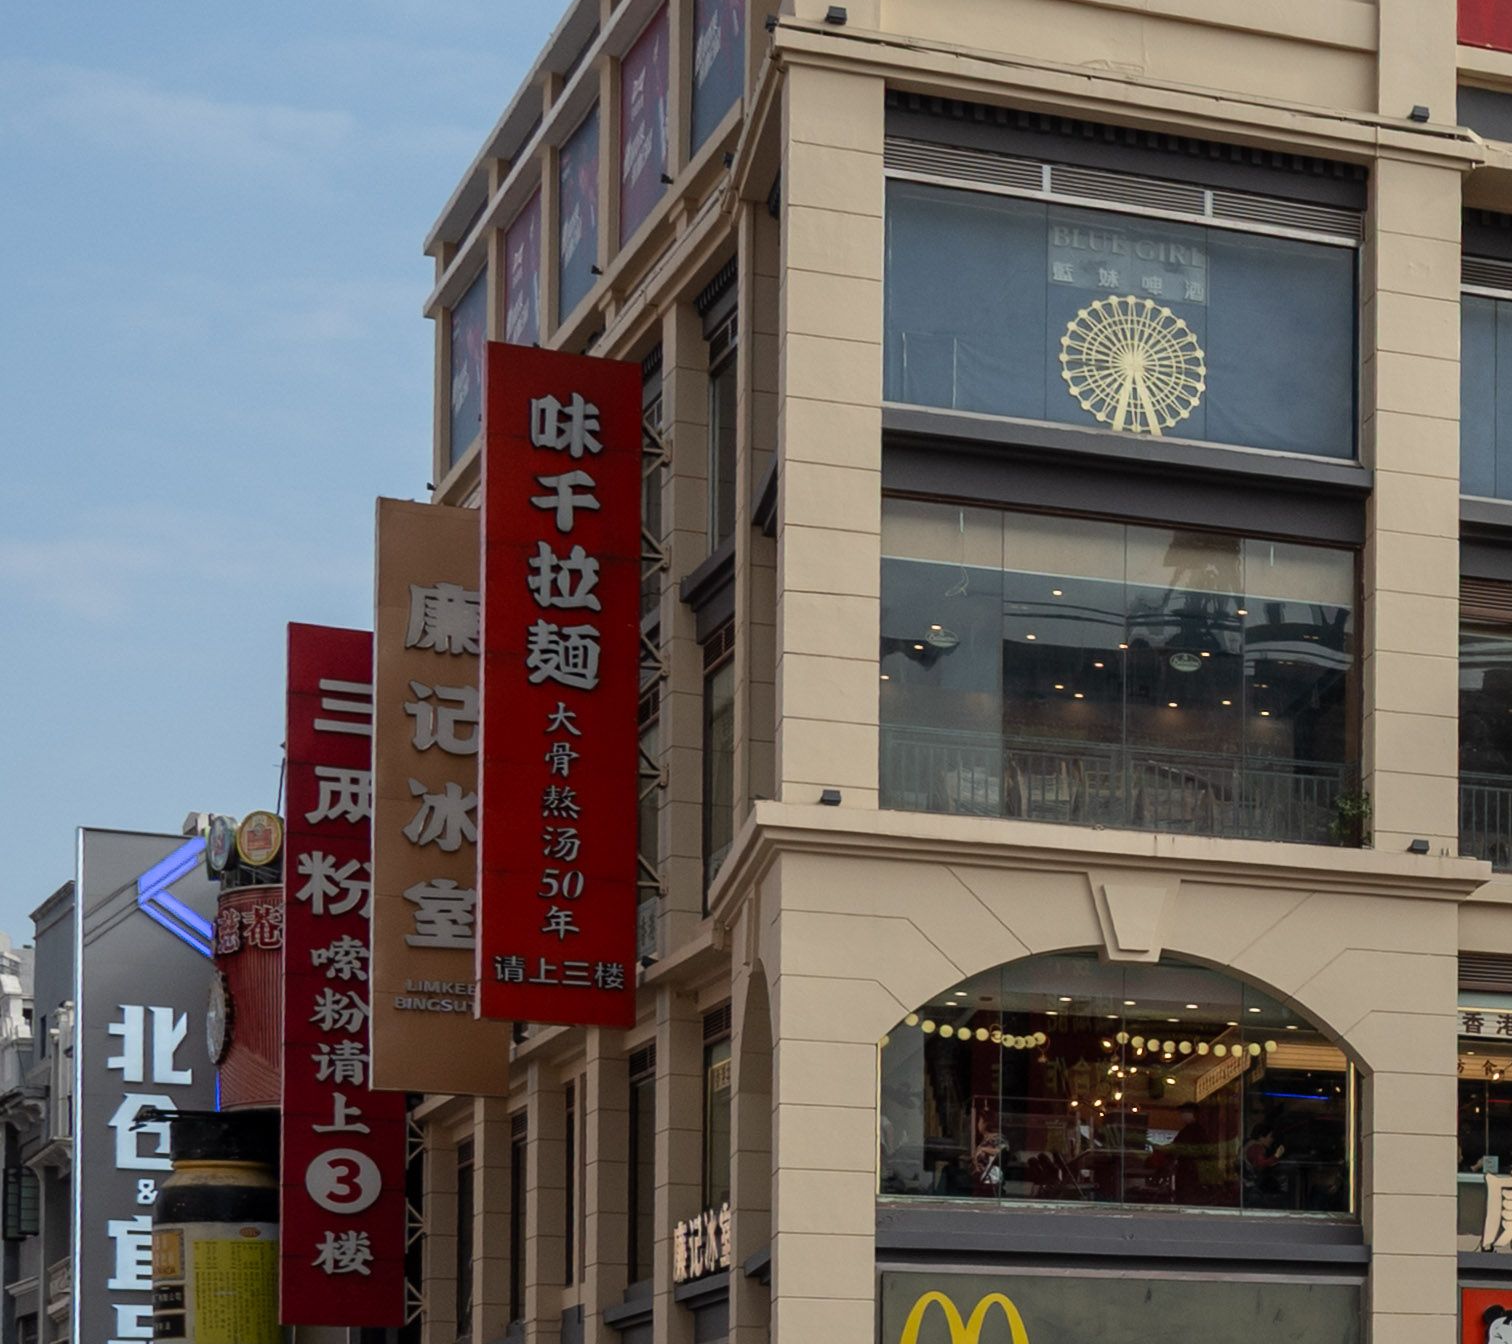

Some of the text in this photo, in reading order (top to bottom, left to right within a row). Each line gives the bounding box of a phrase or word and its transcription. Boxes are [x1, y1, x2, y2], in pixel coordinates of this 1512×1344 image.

[538, 700, 585, 940] 大骨熬汤50年
[493, 956, 626, 992] 请上三楼
